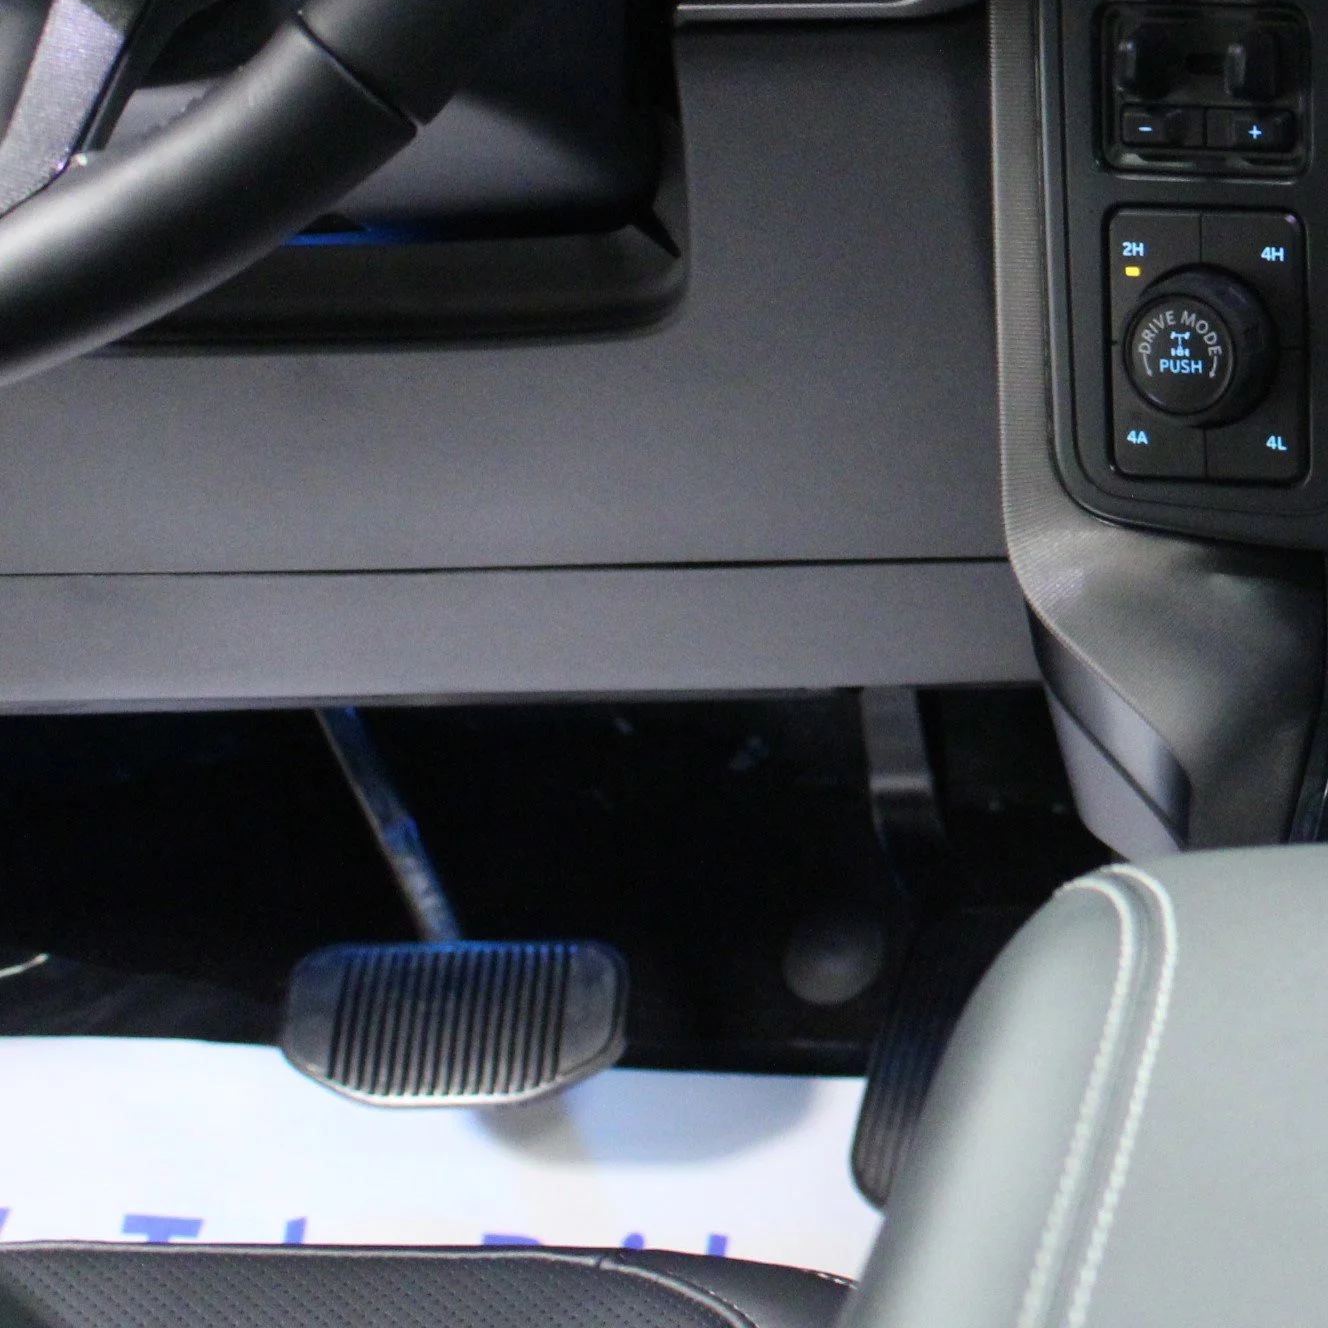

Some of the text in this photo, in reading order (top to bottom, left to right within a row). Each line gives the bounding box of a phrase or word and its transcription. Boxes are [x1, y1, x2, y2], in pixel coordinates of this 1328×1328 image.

[1123, 242, 1144, 256] 2H
[1261, 247, 1284, 261] 4H
[1138, 309, 1222, 356] DRIVE MODE
[1160, 359, 1202, 373] PUSH
[1127, 430, 1148, 444] 4A
[1266, 436, 1287, 450] 4L
